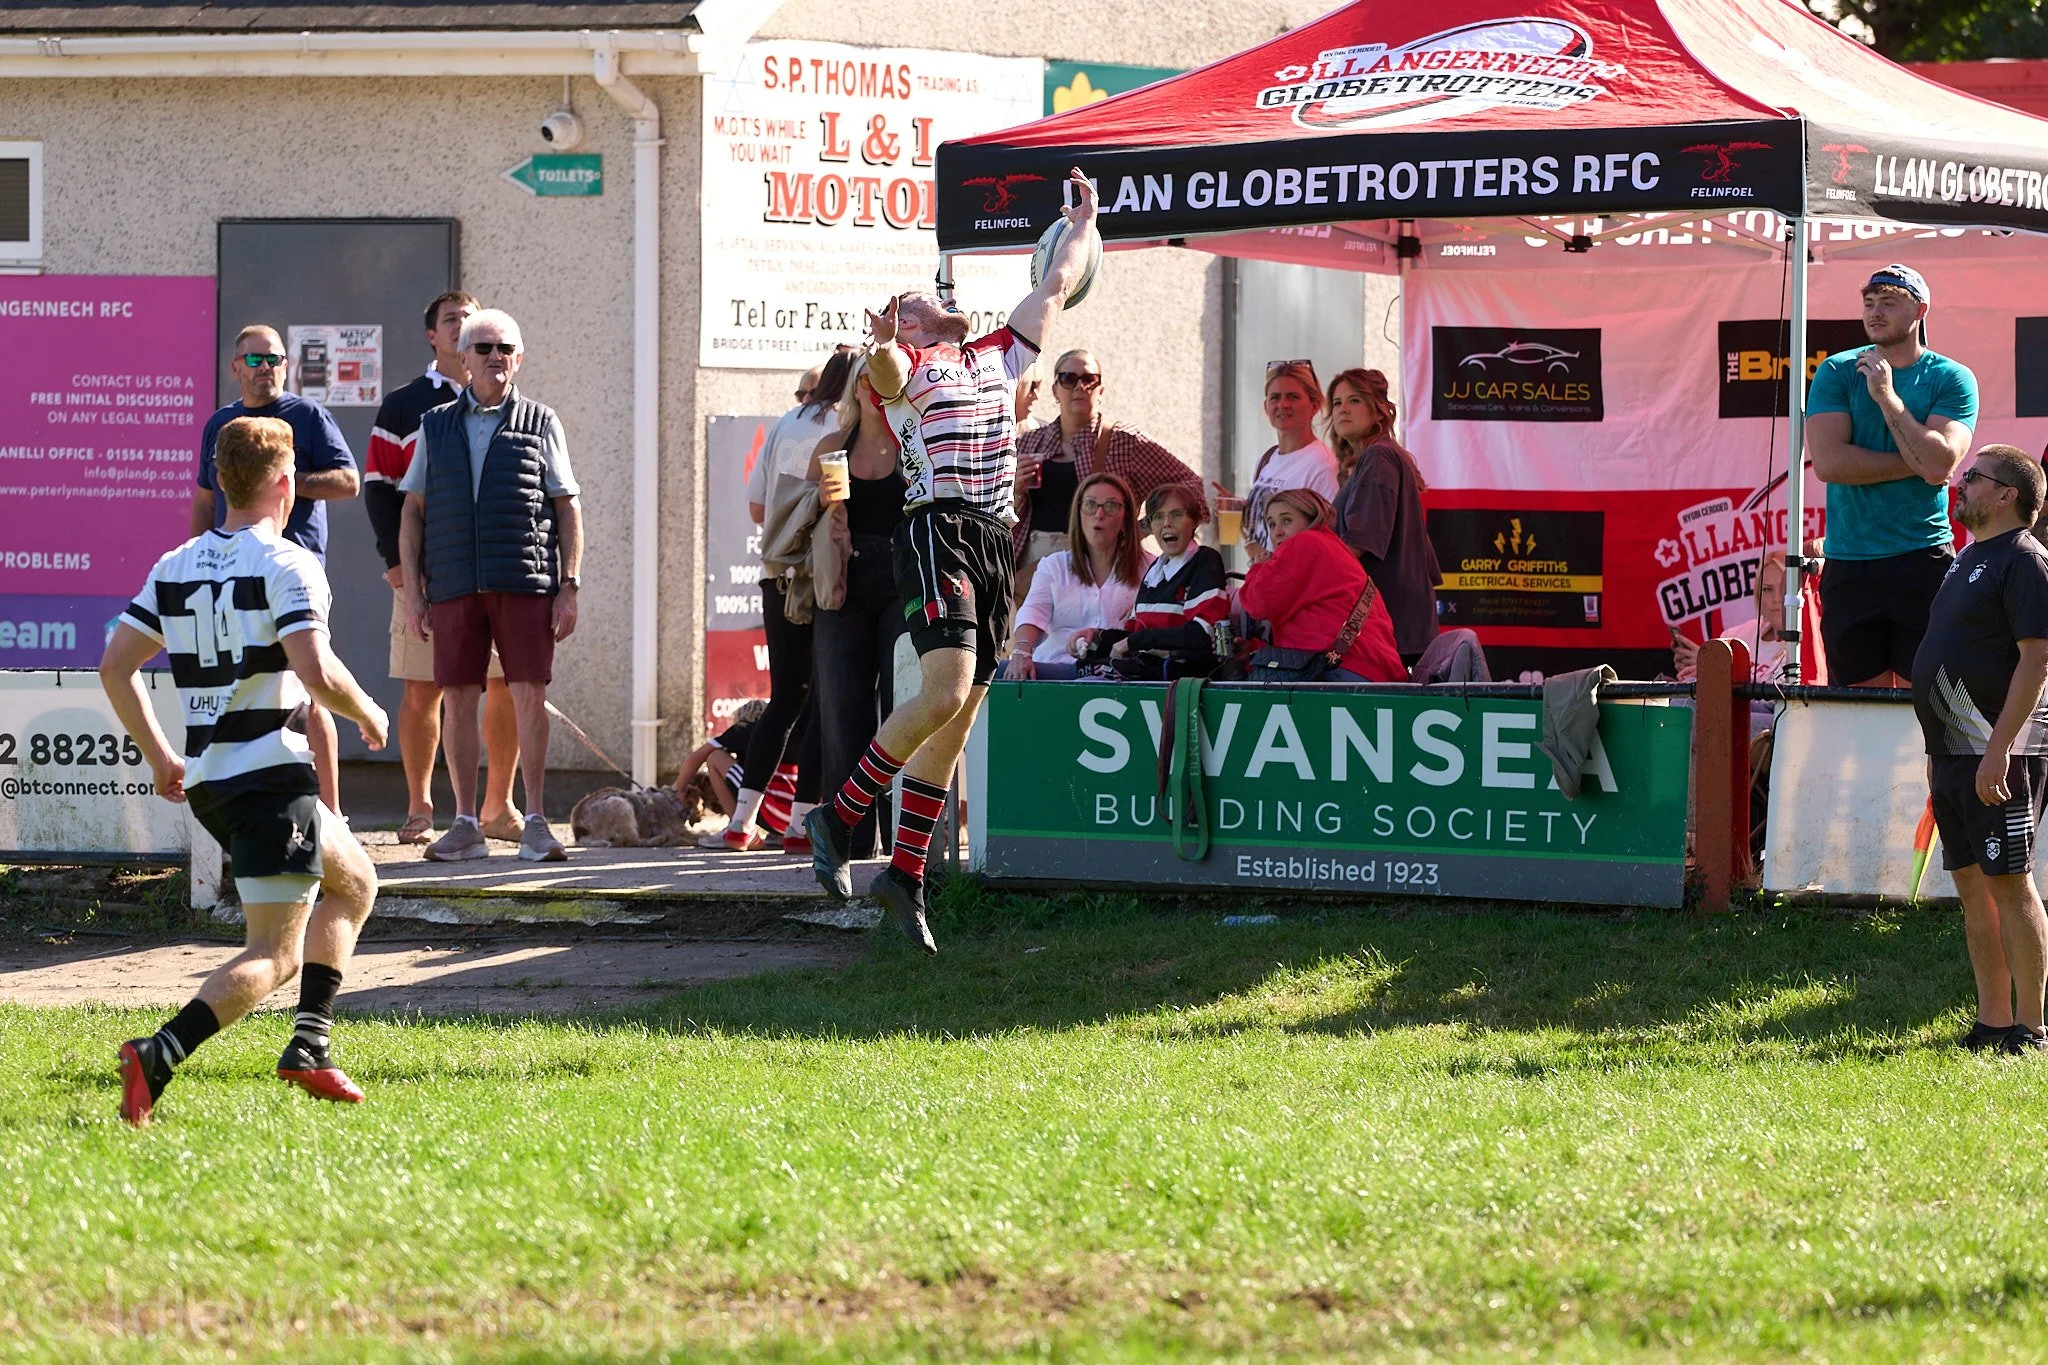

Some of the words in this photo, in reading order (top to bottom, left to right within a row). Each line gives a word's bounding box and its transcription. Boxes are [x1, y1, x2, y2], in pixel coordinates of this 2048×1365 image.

[810, 58, 911, 100] THOMAS
[917, 75, 961, 92] TRADING
[1262, 74, 1600, 105] GLOBETROTTERS
[766, 119, 806, 139] WHILE
[820, 112, 850, 162] L
[861, 114, 900, 166] &
[729, 143, 756, 162] YOU
[760, 145, 792, 164] WAIT
[538, 169, 595, 183] TOILETS
[1186, 155, 1559, 210] GLOBETROTTERS
[1572, 152, 1661, 193] RFC
[1874, 154, 1937, 199] LLAN
[1690, 186, 1754, 198] FELINFOEL
[1825, 187, 1857, 201] FELINFOEL
[974, 217, 1031, 230] FELINFOEL
[100, 301, 134, 318] RFC
[731, 299, 766, 329] Tel
[775, 307, 799, 329] or
[805, 302, 856, 331] Fax:
[712, 337, 752, 351] BRIDGE
[926, 368, 955, 383] CK
[1727, 352, 1739, 383] THE
[72, 374, 131, 388] CONTACT
[136, 376, 151, 388] US
[155, 376, 181, 389] FOR
[184, 376, 194, 388] A
[1443, 381, 1471, 399] JJ
[1474, 382, 1517, 400] CAR
[1522, 382, 1591, 401] SALES
[31, 392, 62, 405] FREE
[66, 393, 112, 406] INITIAL
[116, 394, 194, 407] DISCUSSION
[47, 411, 67, 423] ON
[71, 411, 98, 424] ANY
[102, 412, 140, 425] LEGAL
[144, 412, 194, 426] MATTER
[49, 448, 94, 460] OFFICE
[106, 449, 144, 461] 01554
[148, 449, 194, 462] 788280
[84, 466, 193, 482] info@plandp.co.uk
[1461, 558, 1501, 571] GARRY
[1507, 560, 1569, 573] GRIFFITHS
[1458, 576, 1519, 588] ELECTRICAL
[1522, 577, 1571, 589] SERVICES
[1095, 793, 1342, 834] BUIDING
[1372, 804, 1598, 845] SOCIETY
[1236, 855, 1376, 882] Established
[1384, 861, 1439, 885] 1923
